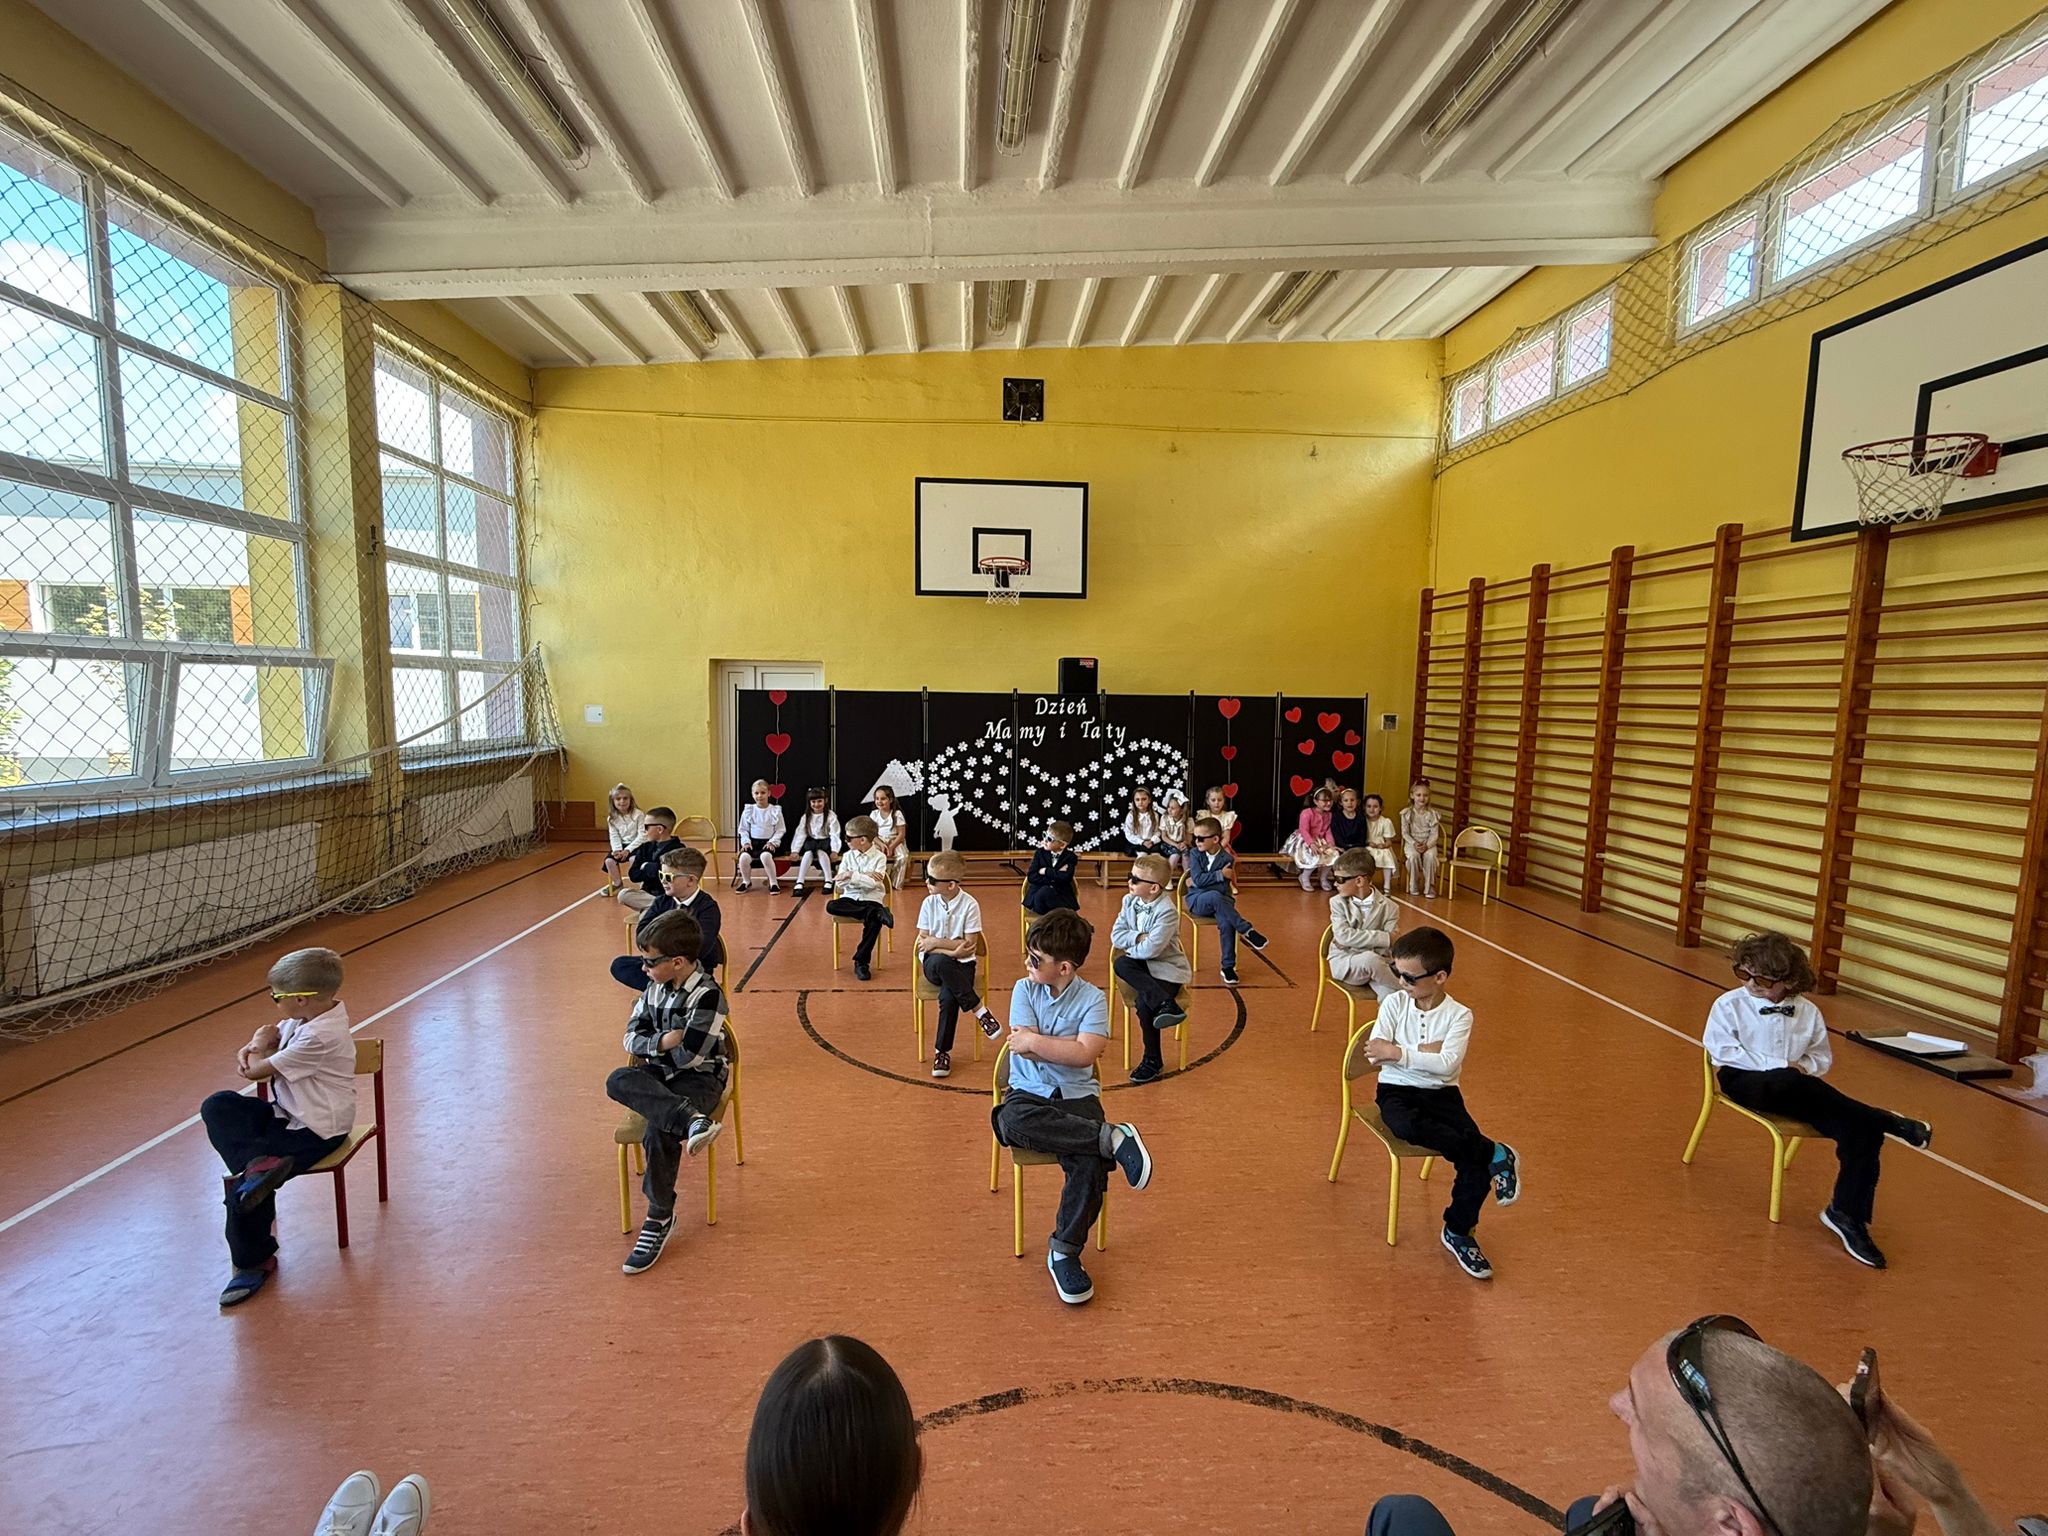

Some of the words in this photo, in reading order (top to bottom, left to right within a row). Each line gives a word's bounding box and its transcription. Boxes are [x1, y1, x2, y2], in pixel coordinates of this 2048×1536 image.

[1034, 697, 1087, 715] Dzień
[984, 718, 1046, 747] Mamy
[1059, 721, 1066, 739] i
[1080, 716, 1126, 747] Taty
